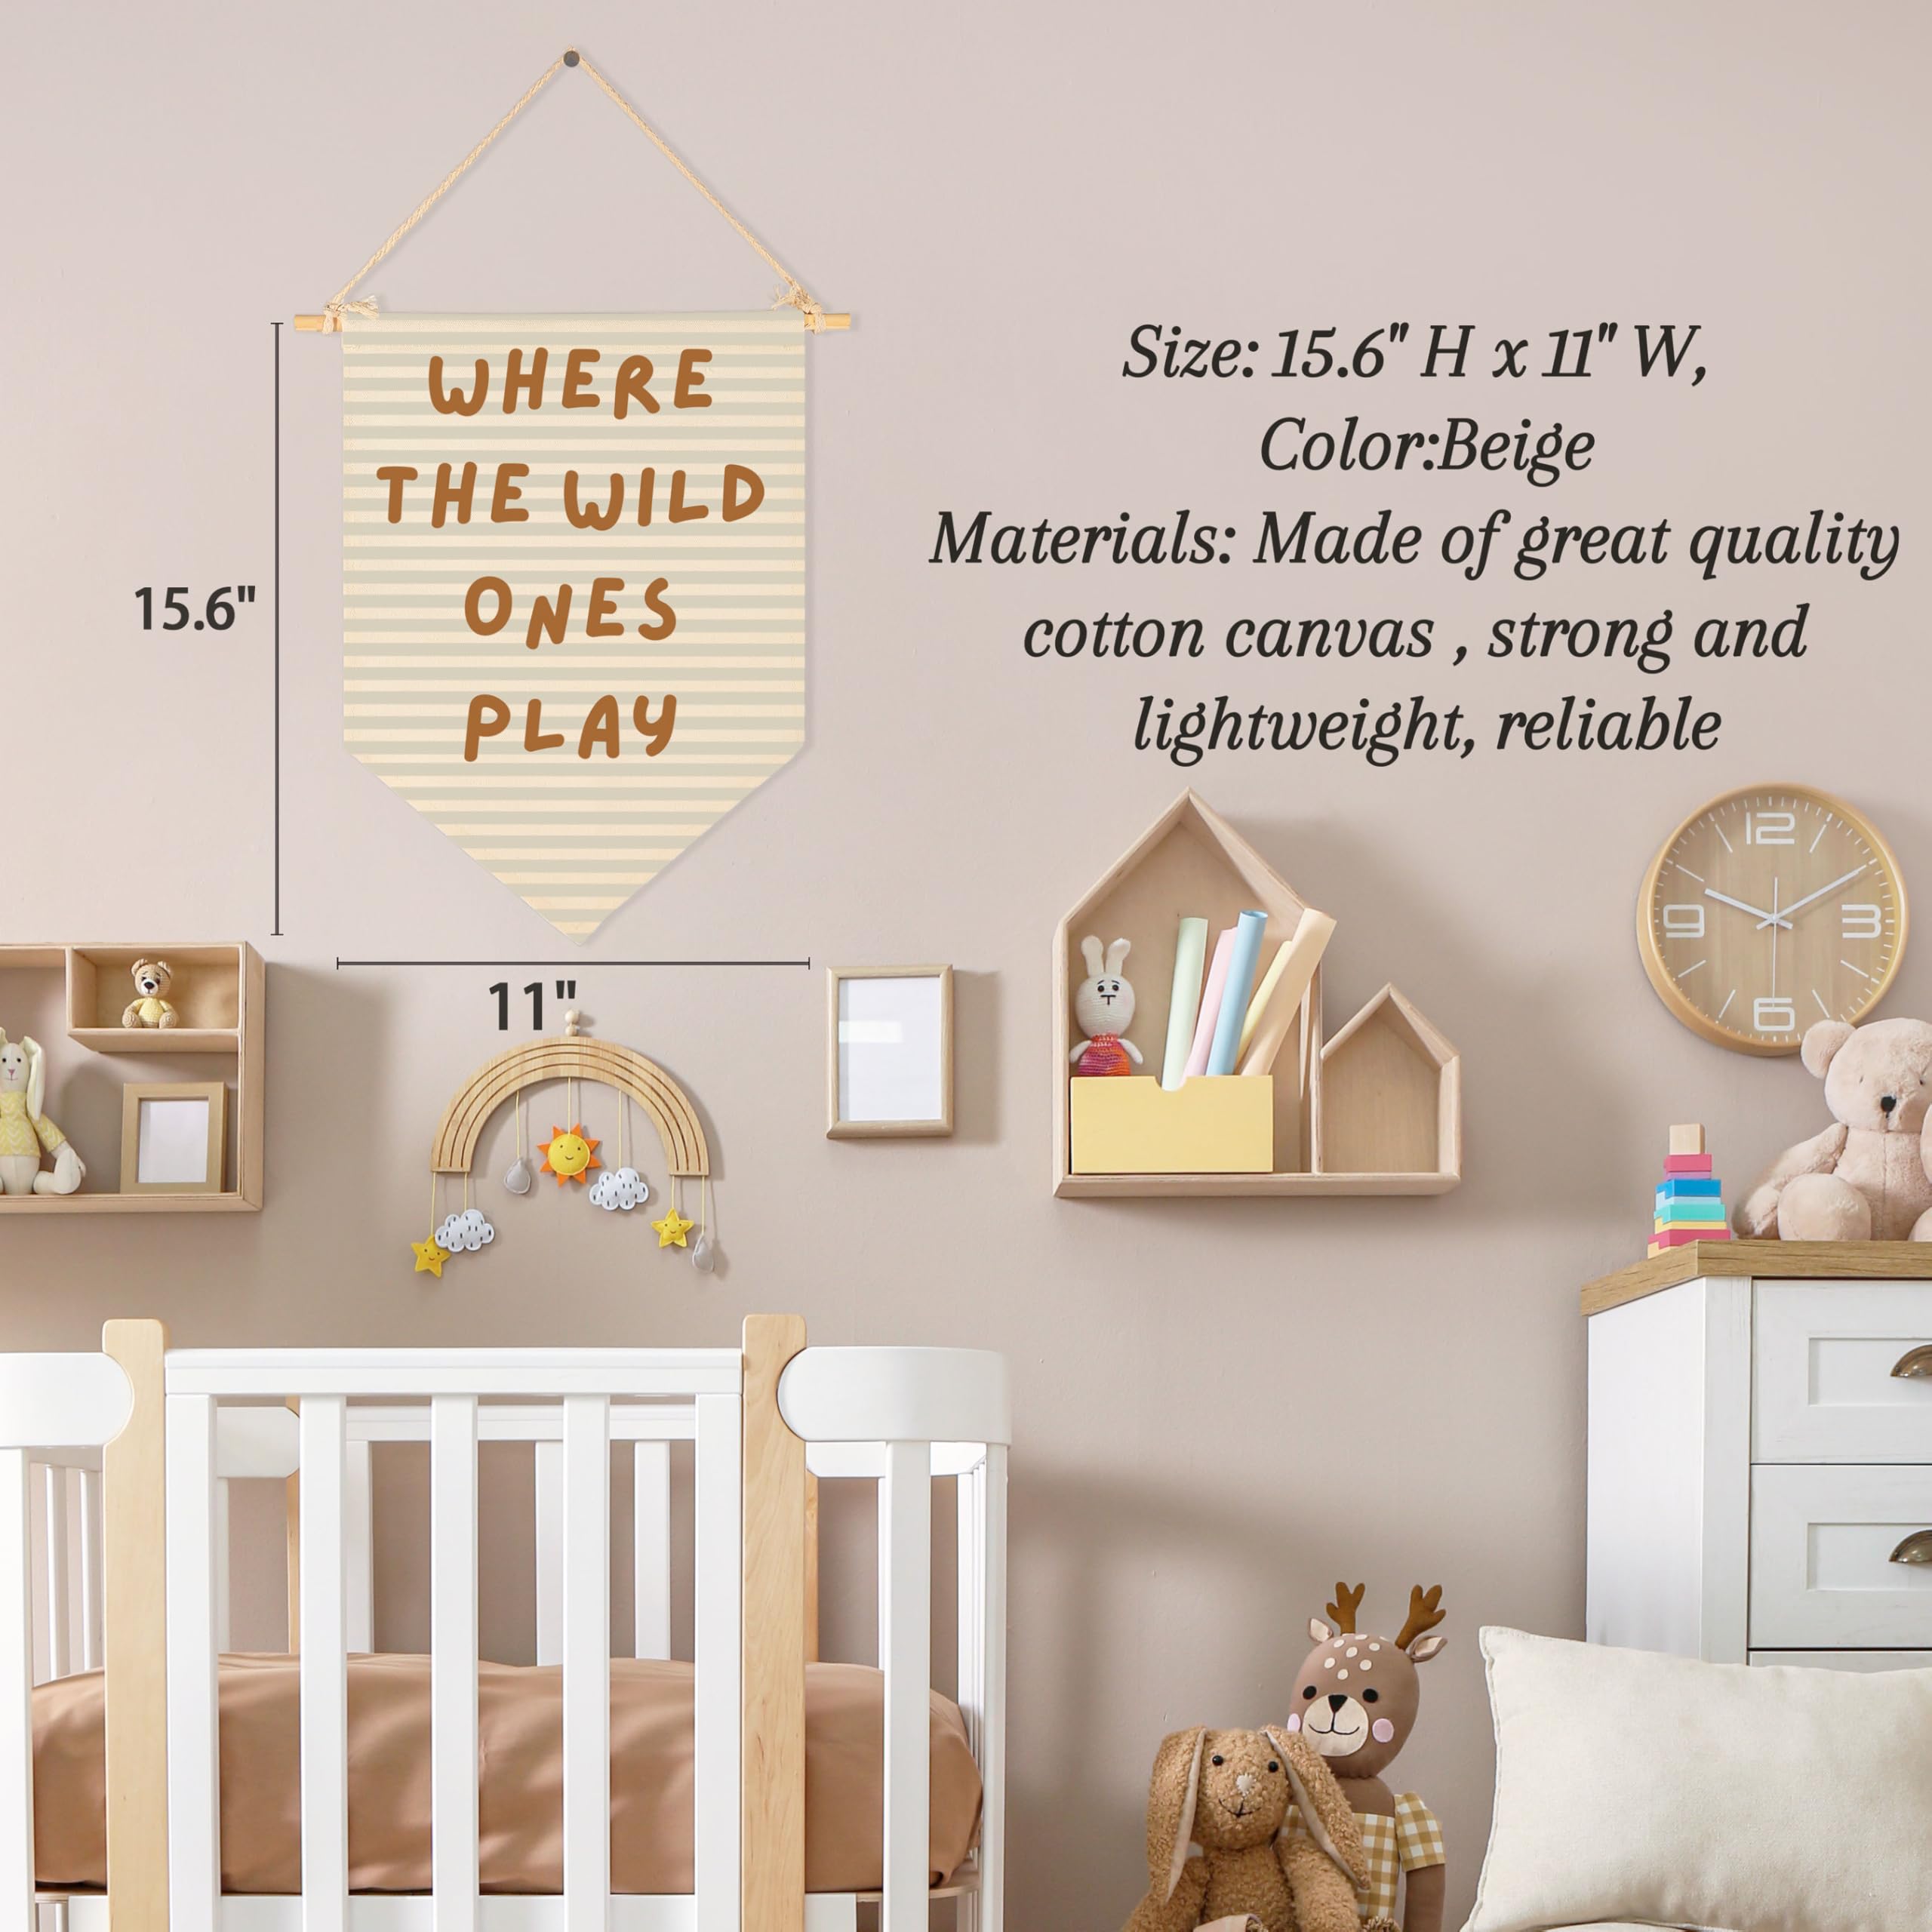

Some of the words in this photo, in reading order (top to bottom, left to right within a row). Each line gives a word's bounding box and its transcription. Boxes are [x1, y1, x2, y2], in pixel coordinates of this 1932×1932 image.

[428, 346, 713, 420] WHERE
[377, 461, 530, 528] THE
[564, 464, 765, 531] WILD
[464, 576, 677, 650] ONES
[464, 694, 677, 762] PLAY
[1746, 811, 1795, 845] 12
[1663, 904, 1705, 938] 9
[1841, 904, 1881, 939] 3
[1753, 997, 1795, 1032] 6
